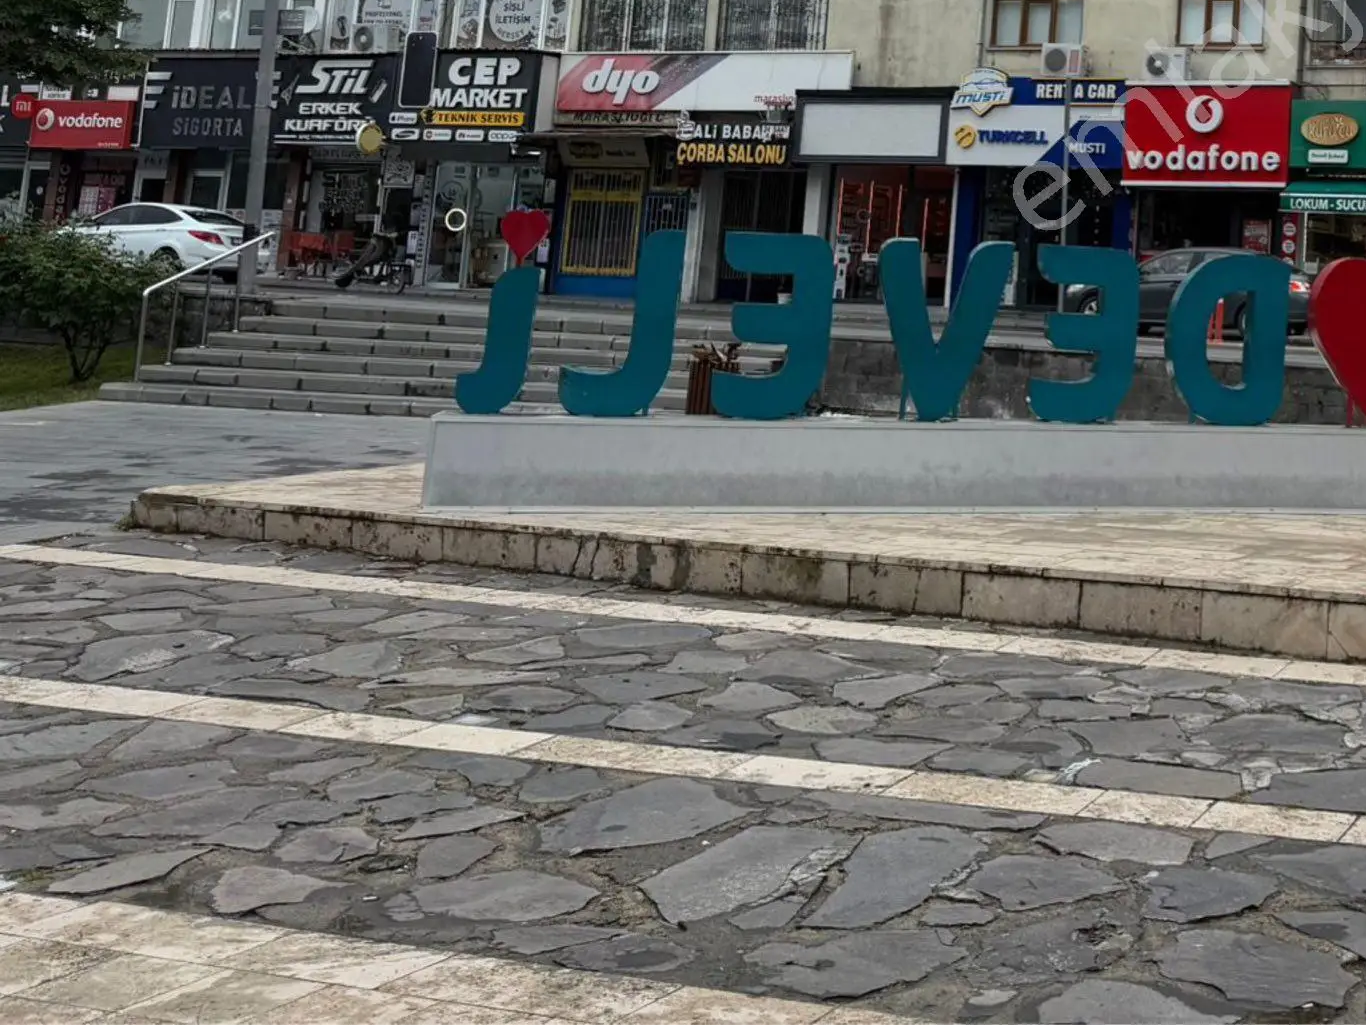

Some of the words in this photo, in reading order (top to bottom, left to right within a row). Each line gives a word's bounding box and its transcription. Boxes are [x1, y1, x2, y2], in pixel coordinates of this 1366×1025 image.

[448, 57, 520, 85] CEP
[581, 58, 660, 105] dyo
[430, 88, 528, 108] MARKET
[1073, 84, 1085, 99] A
[1088, 84, 1117, 99] CAR
[299, 103, 363, 115] ERKEK
[59, 113, 123, 128] vodafone
[977, 129, 1048, 145] TURKCELL
[677, 143, 725, 164] ÇORBA
[727, 144, 787, 164] SALONU
[1127, 144, 1280, 171] vodafone
[1290, 198, 1329, 210] LOKUM
